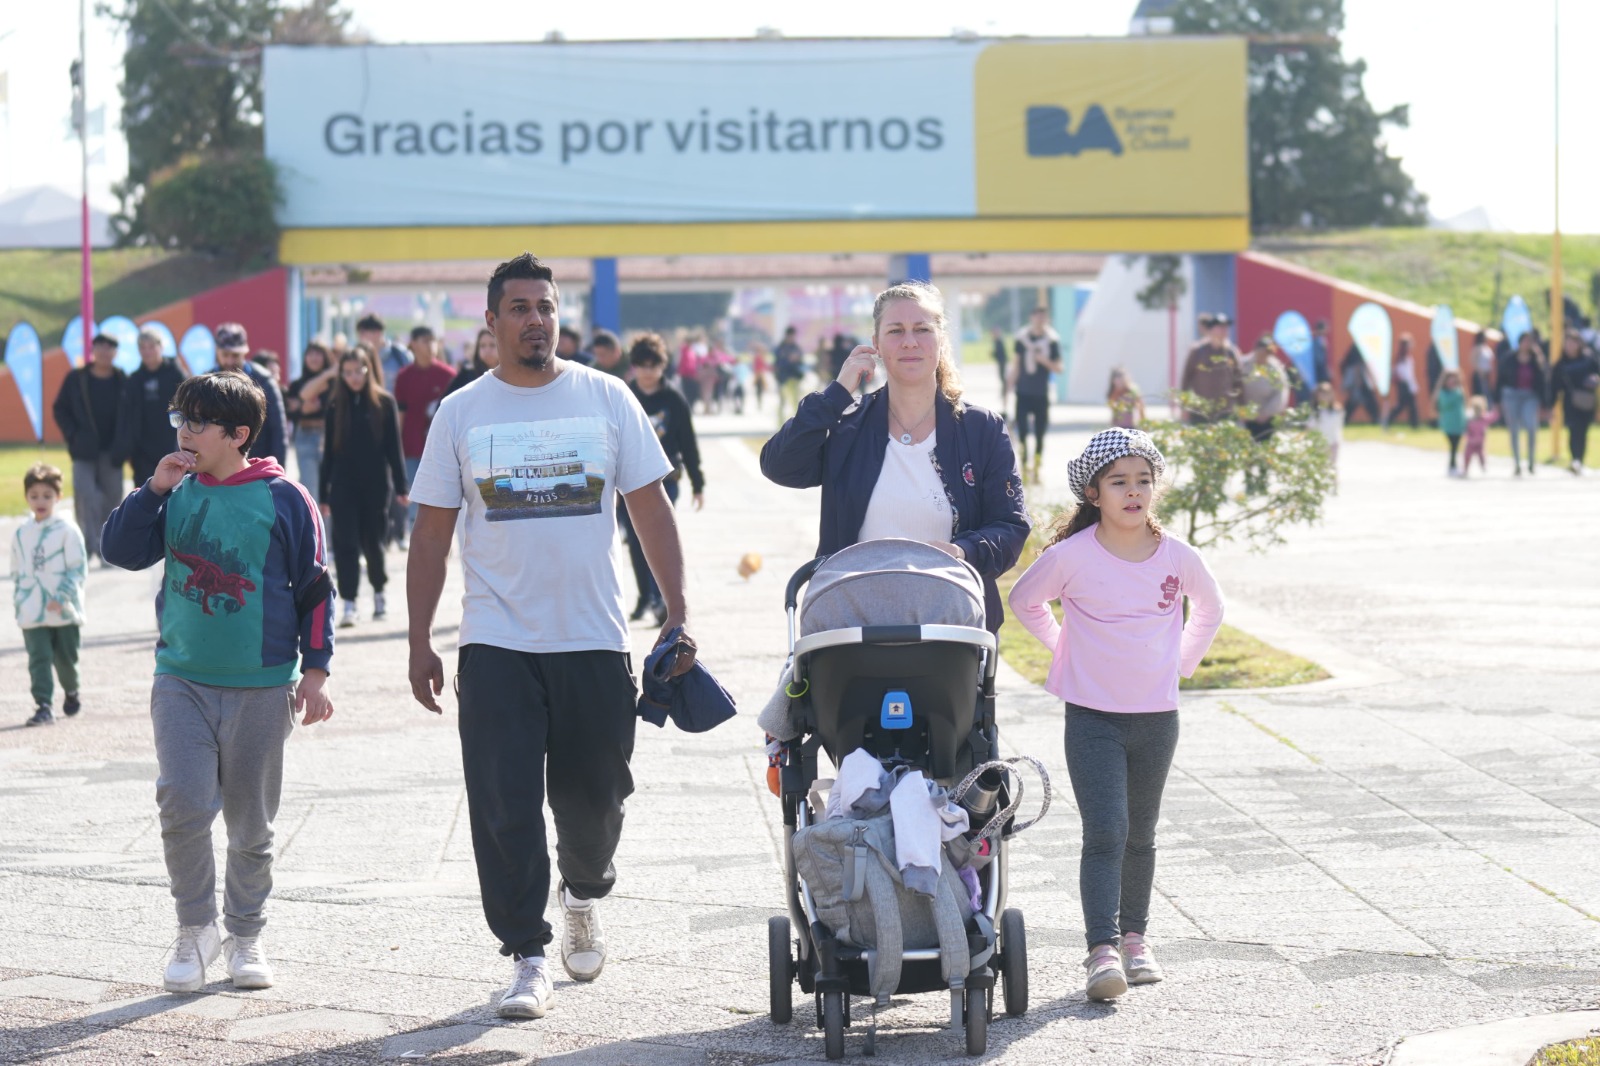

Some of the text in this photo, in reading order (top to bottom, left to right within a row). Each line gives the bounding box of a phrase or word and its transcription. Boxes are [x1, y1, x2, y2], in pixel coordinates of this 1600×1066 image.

[323, 108, 945, 165] Gracias por visitarnos
[1026, 103, 1124, 157] BA
